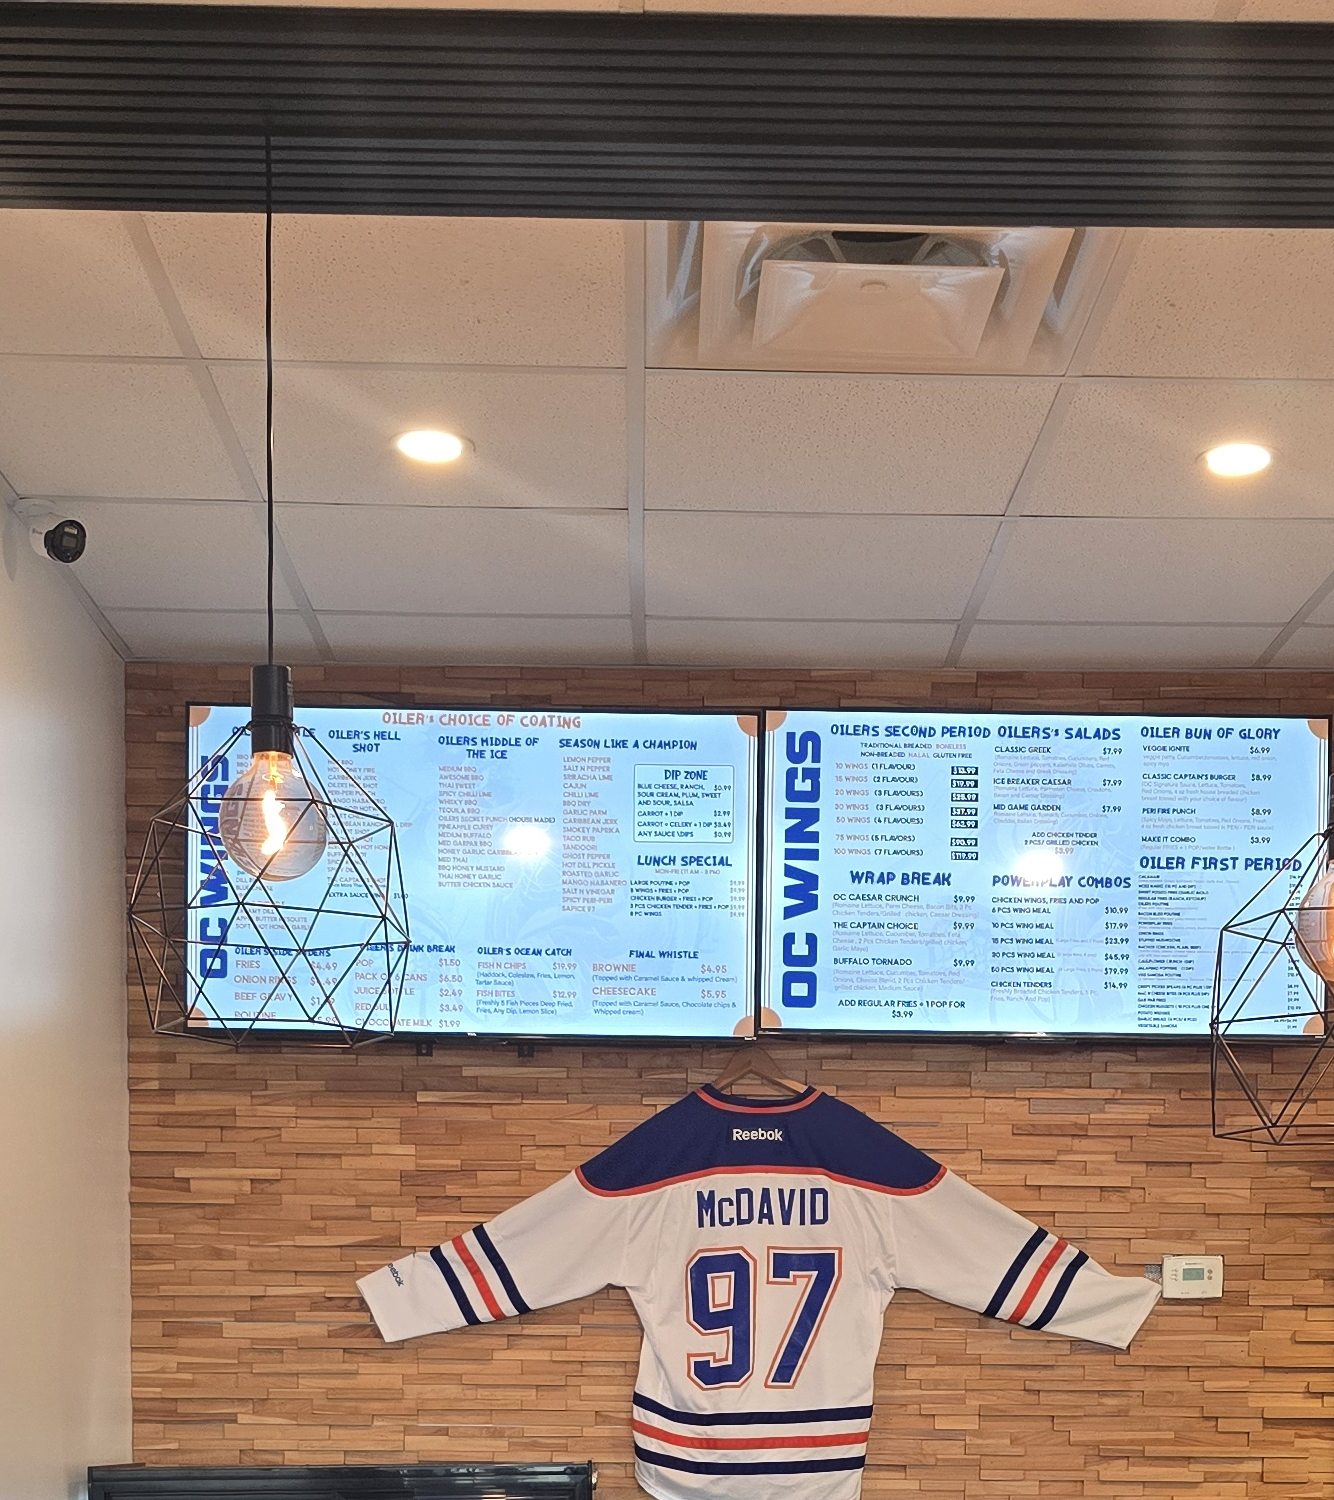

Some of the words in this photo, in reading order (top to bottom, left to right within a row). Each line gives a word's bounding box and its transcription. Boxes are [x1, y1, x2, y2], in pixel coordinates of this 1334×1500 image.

[382, 712, 434, 725] OILER's
[439, 713, 491, 726] CHOICE
[497, 714, 515, 725] OF
[520, 715, 581, 729] COATING
[329, 730, 370, 740] OILER'S
[373, 731, 401, 741] HELL
[831, 724, 879, 737] OILERS
[885, 725, 936, 738] SECOND
[941, 726, 991, 738] PERIOD
[1065, 727, 1121, 740] SALADS
[1140, 726, 1180, 739] OILER
[1185, 727, 1212, 740] BUN
[1217, 728, 1234, 739] OF
[1238, 728, 1281, 740] GLORY
[438, 736, 477, 746] OILERS
[481, 737, 522, 747] MIDDLE
[525, 737, 539, 746] OF
[559, 738, 600, 749] SEASON
[604, 739, 628, 749] LIKE
[633, 740, 639, 749] A
[642, 740, 697, 750] CHAMPION
[353, 743, 380, 753] SHOT
[1103, 747, 1122, 755] $7.99
[1250, 746, 1270, 754] $6.99
[467, 749, 486, 759] THE
[490, 750, 508, 759] ICE
[664, 770, 682, 781] DIP
[684, 770, 708, 780] ZONE
[1251, 774, 1271, 782] $8.99
[1103, 779, 1122, 787] $7.99
[1102, 805, 1121, 813] $7.99
[1251, 808, 1271, 816] $8.99
[784, 730, 821, 920] WINGS
[1250, 836, 1270, 844] $3.99
[637, 855, 676, 866] LUNCH
[681, 855, 732, 867] SPECIAL
[1139, 856, 1185, 870] OILER
[1191, 857, 1239, 871] FIRST
[1244, 857, 1302, 872] PERIOD
[850, 870, 896, 885] WRAP
[901, 871, 952, 886] BREAK
[1078, 876, 1131, 888] COMBOS
[953, 895, 975, 904] $9.99
[849, 922, 885, 930] CAPTAIN
[886, 922, 919, 930] CHOICE
[953, 922, 975, 930] $9.99
[1105, 922, 1128, 930] $17.99
[1105, 937, 1129, 945] $23.99
[514, 947, 542, 956] OCEAN
[545, 948, 572, 957] CATCH
[629, 950, 655, 959] FINAL
[658, 950, 699, 959] WHISTLE
[235, 960, 260, 968] FRIES
[438, 958, 460, 967] $1.50
[552, 962, 577, 970] $19.99
[871, 958, 912, 966] TORNADO
[953, 959, 975, 968] $9.99
[592, 964, 636, 972] BROWNIE
[700, 964, 727, 974] $4.95
[782, 932, 818, 1008] OC
[234, 975, 267, 984] ONION
[438, 974, 463, 984] $6.50
[439, 988, 463, 997] $2.49
[552, 990, 577, 999] $12.99
[592, 987, 656, 996] CHEESECAKE
[700, 989, 726, 999] $5.95
[439, 1003, 463, 1013] $3.49
[412, 1019, 432, 1027] MILK
[439, 1019, 460, 1028] $1.99
[732, 1128, 783, 1141] Reebok
[696, 1187, 830, 1228] McDAVID
[387, 1263, 404, 1287] eebok
[684, 1245, 843, 1391] 97
